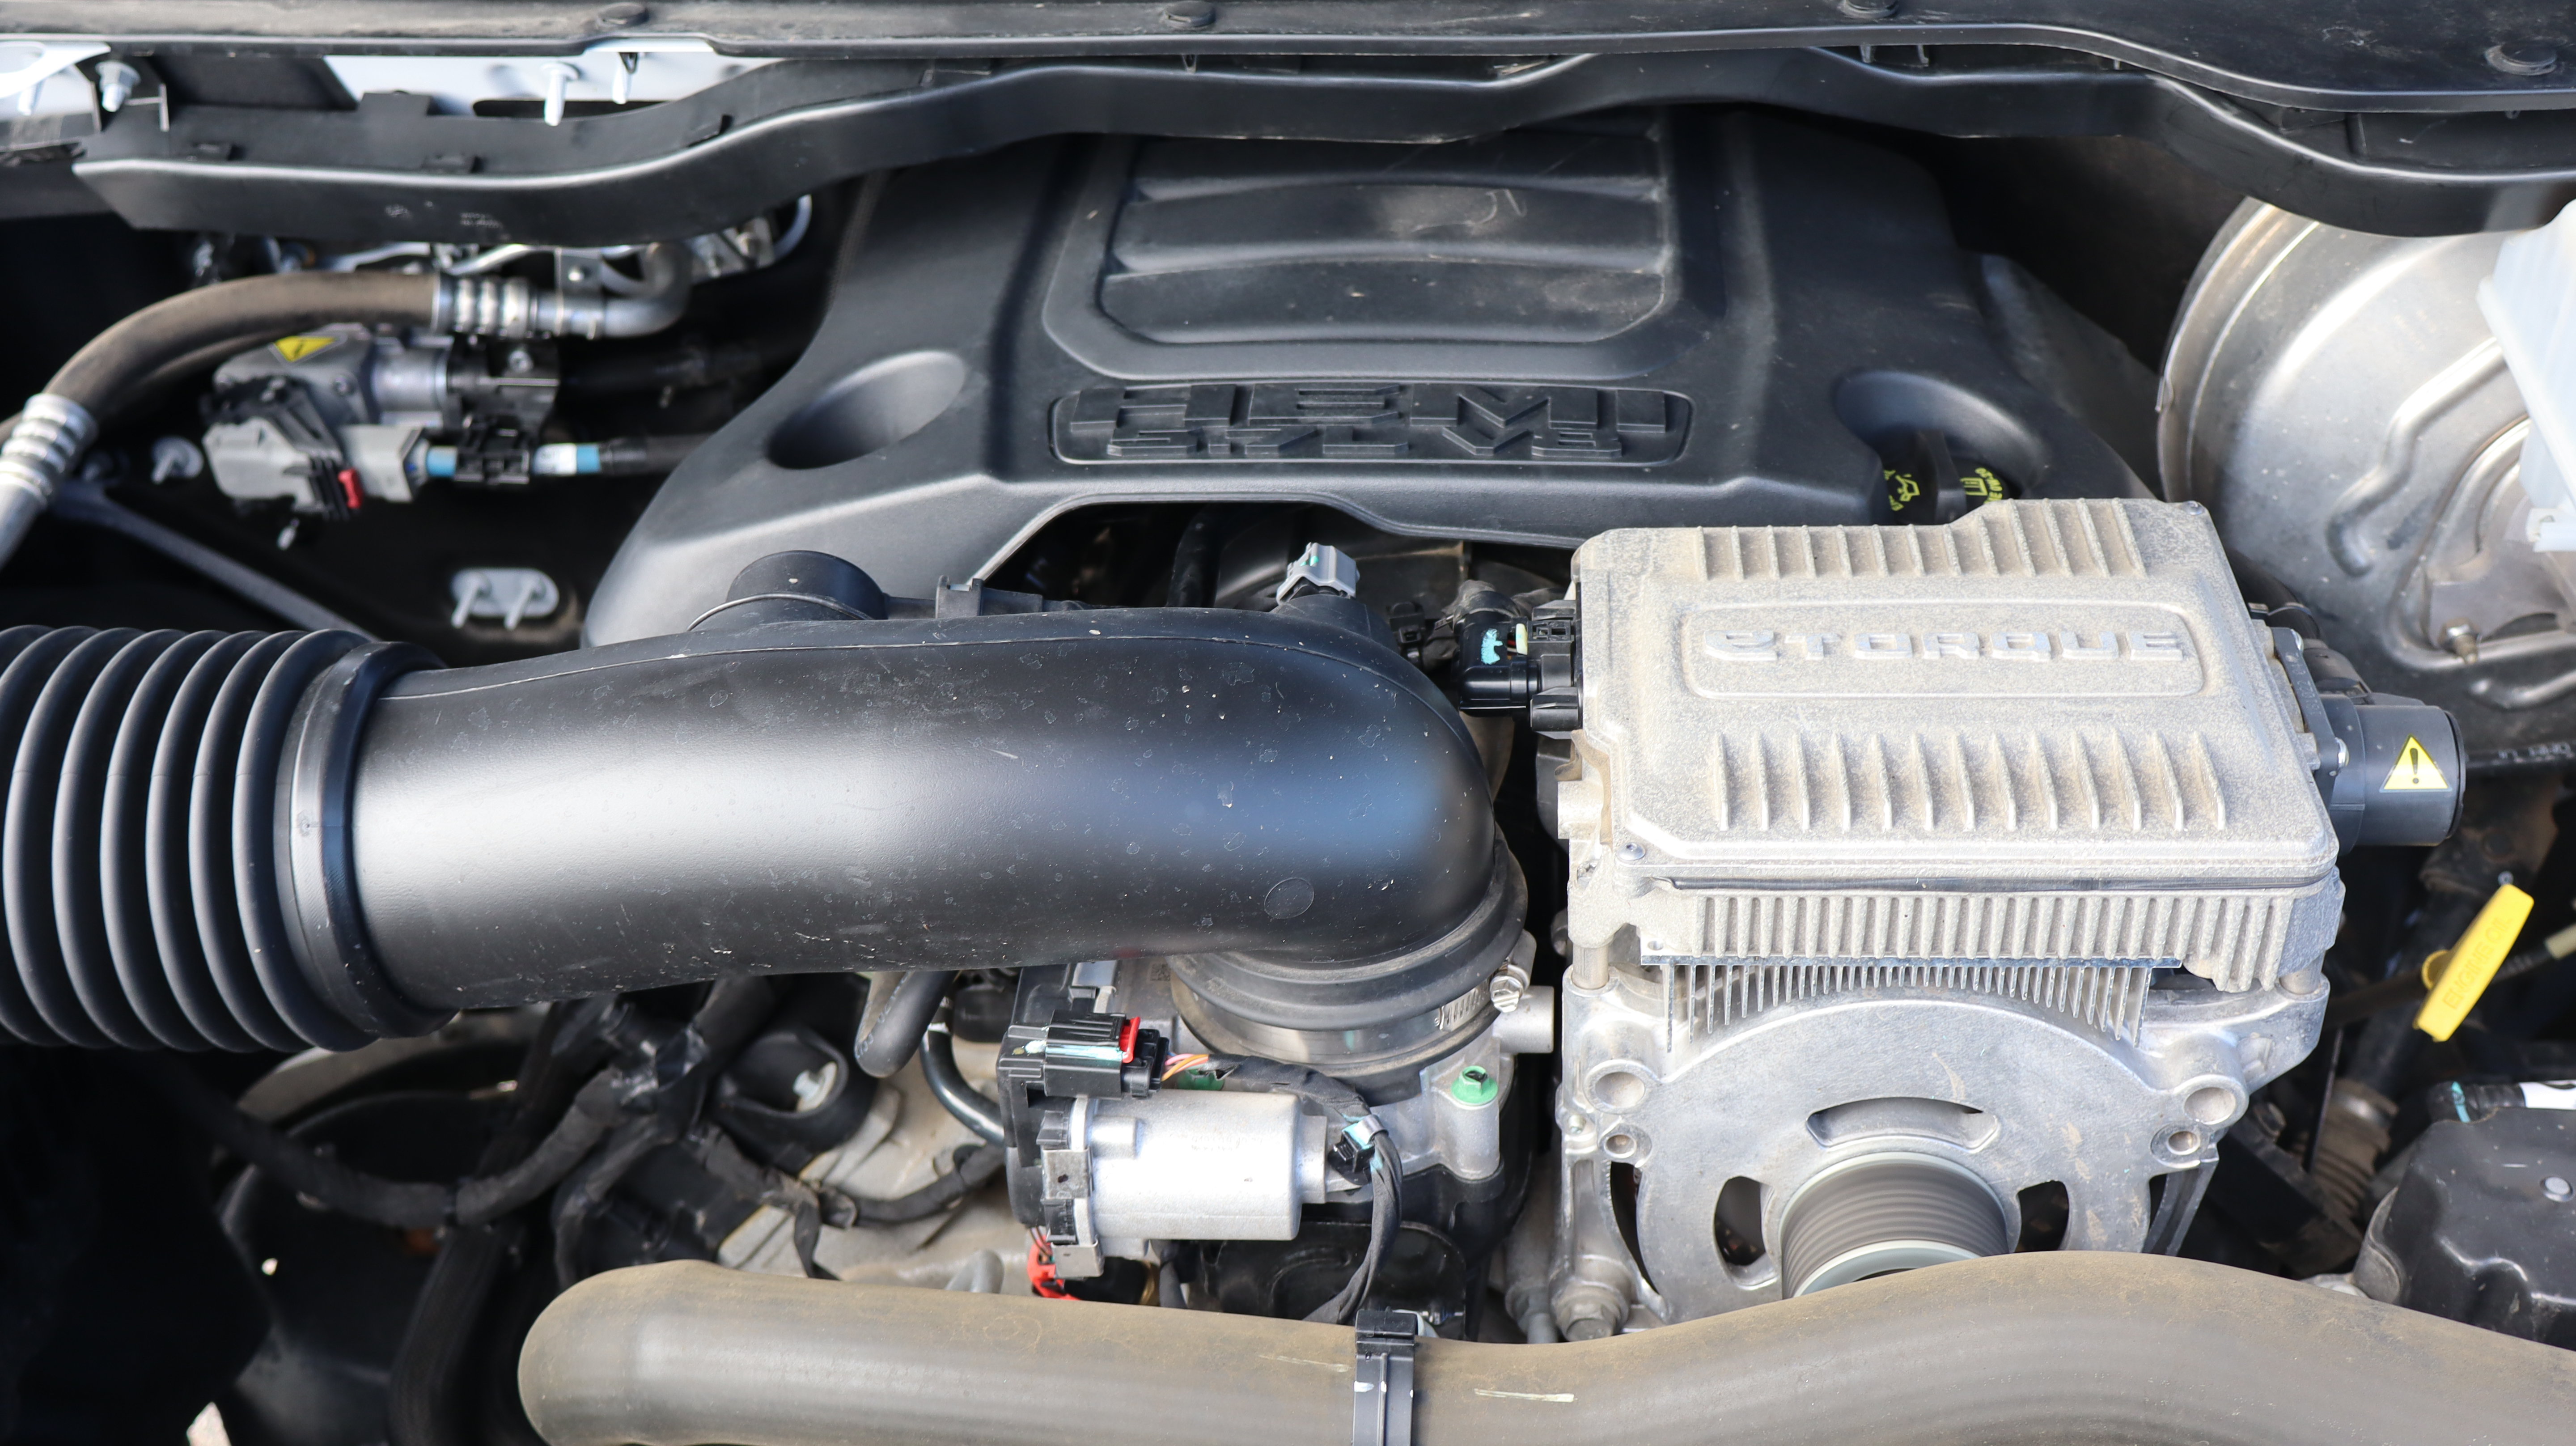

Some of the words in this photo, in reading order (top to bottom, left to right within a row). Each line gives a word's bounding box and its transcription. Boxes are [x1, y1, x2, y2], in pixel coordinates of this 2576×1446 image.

[1071, 383, 1666, 433] HEMI
[2442, 941, 2494, 1010] ENGINE
[2485, 917, 2515, 944] OIL
